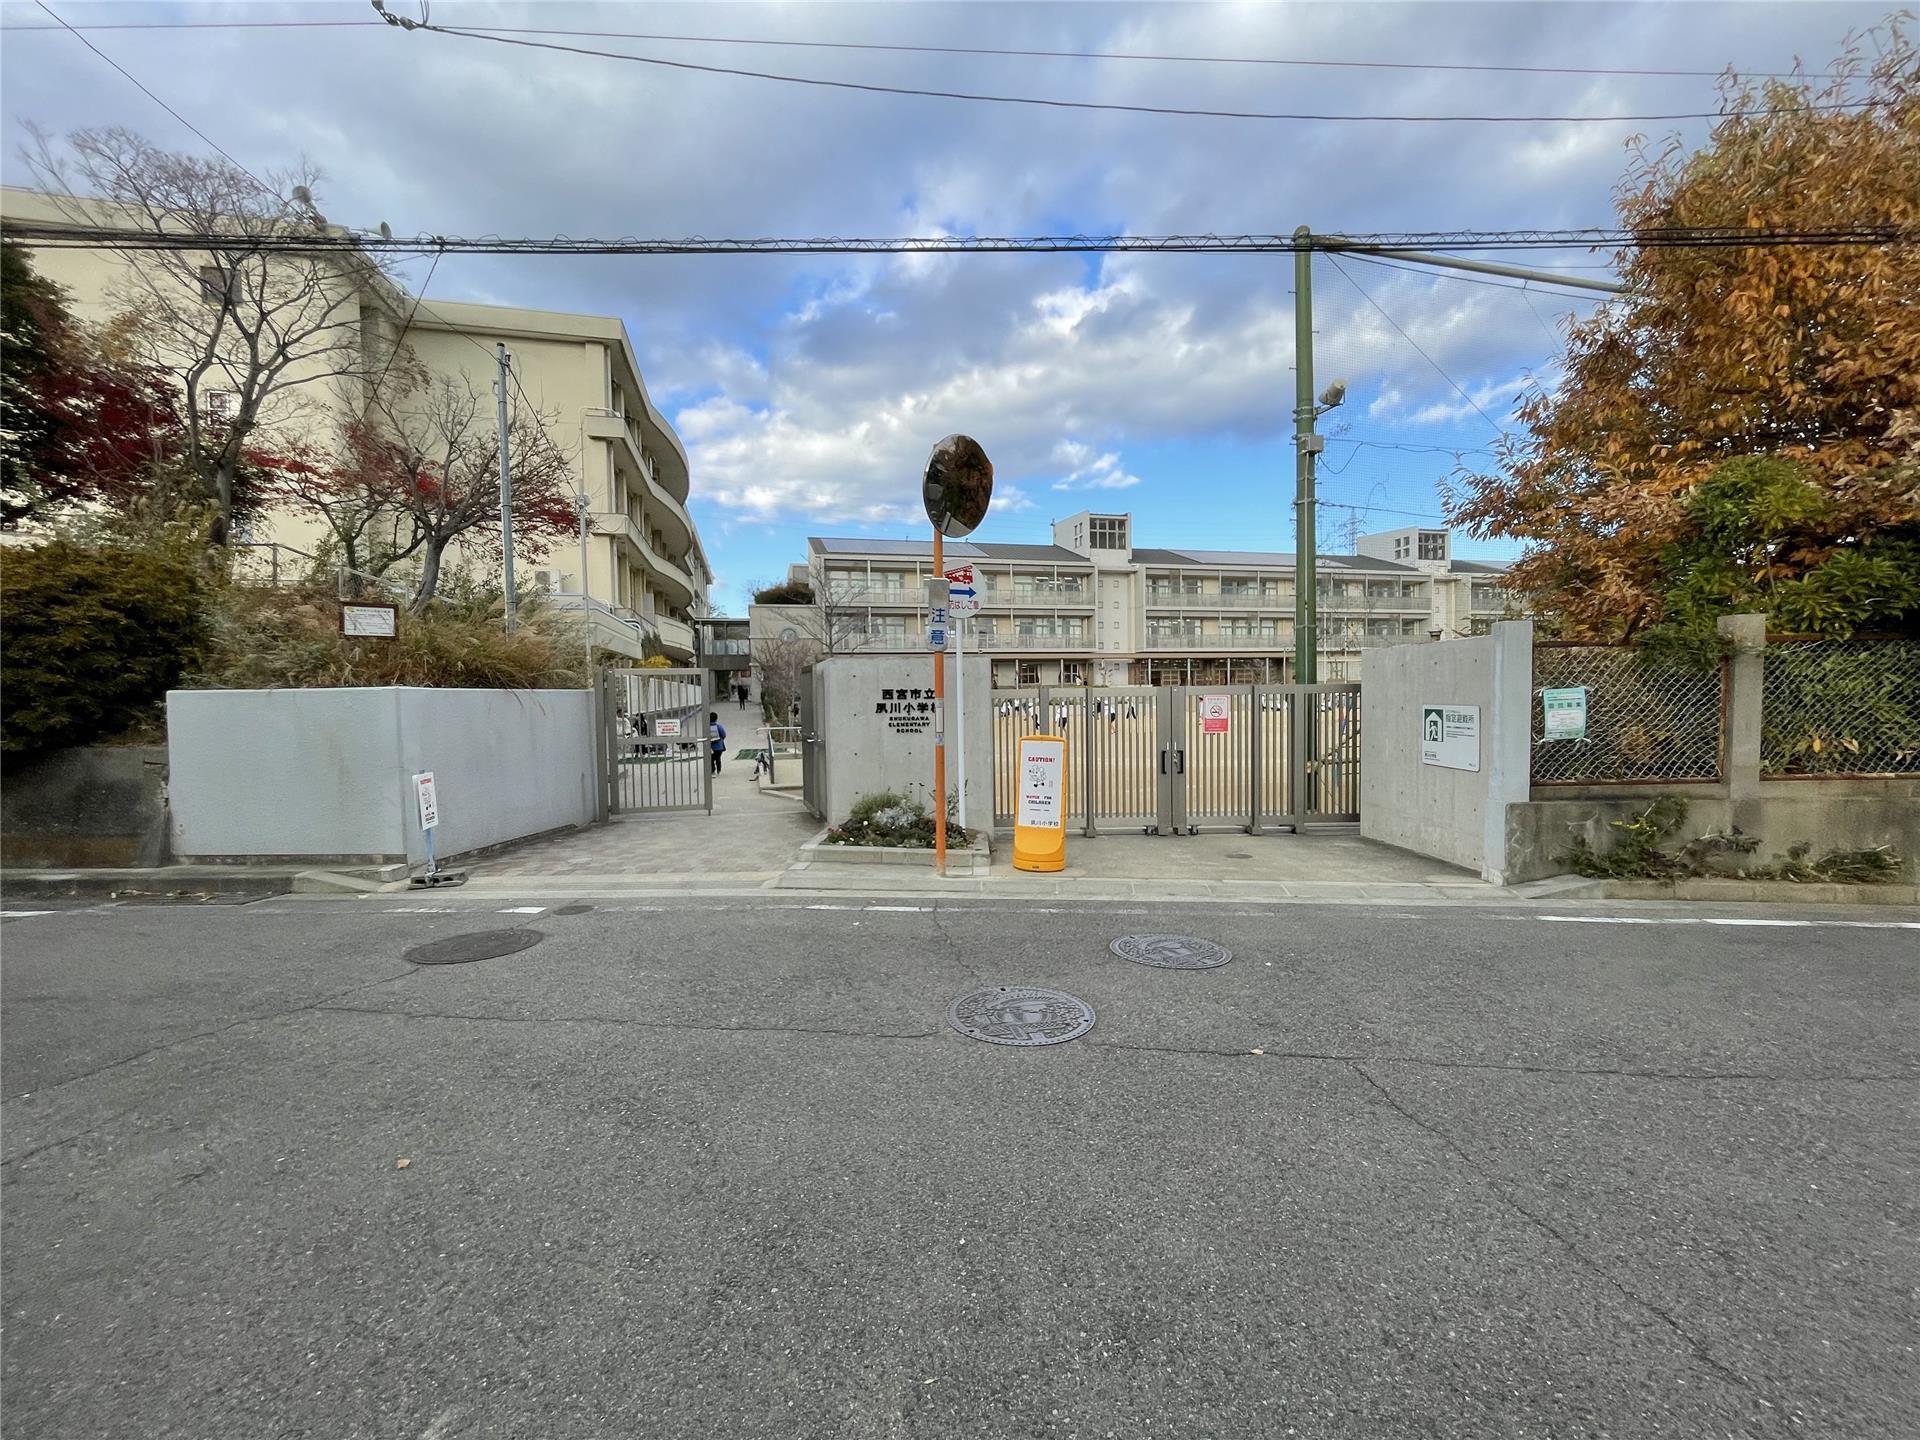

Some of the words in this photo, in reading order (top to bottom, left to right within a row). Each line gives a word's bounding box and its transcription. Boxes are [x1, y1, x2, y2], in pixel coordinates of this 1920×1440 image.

[930, 608, 945, 644] 注意
[881, 688, 936, 700] 西宮市立
